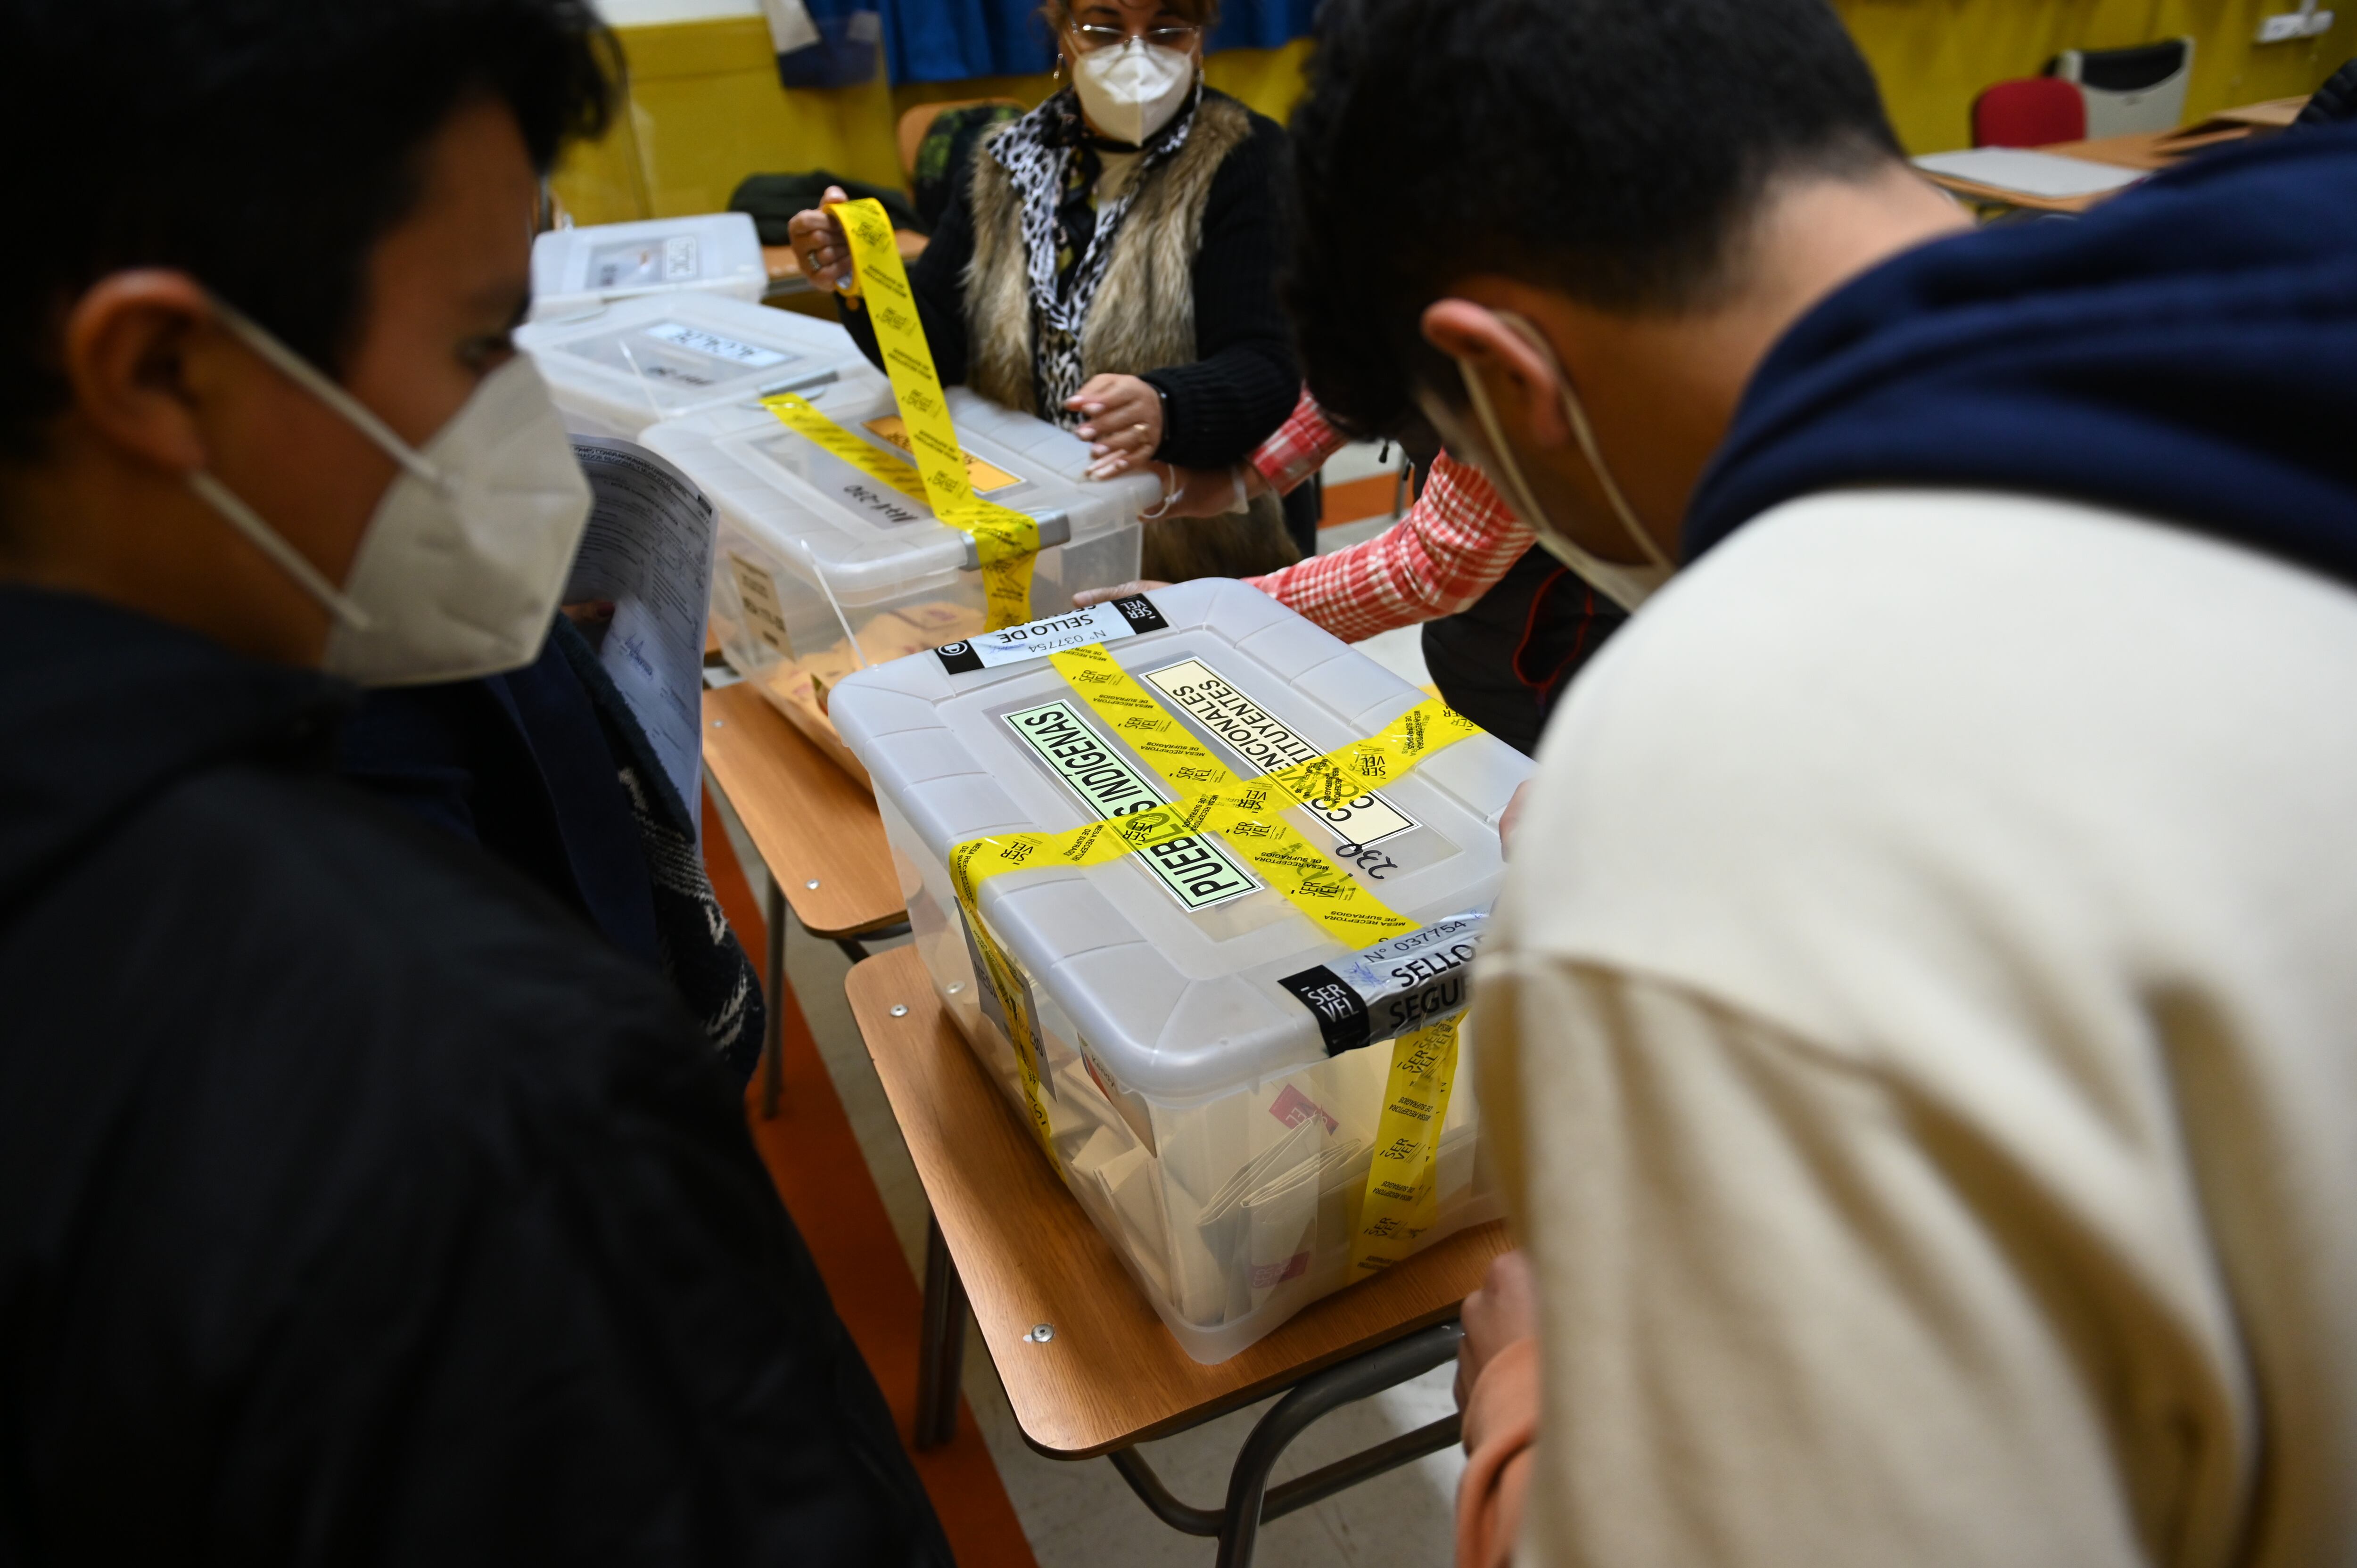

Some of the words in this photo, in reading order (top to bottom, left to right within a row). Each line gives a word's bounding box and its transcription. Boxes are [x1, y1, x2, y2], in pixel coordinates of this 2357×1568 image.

[1120, 600, 1146, 610] VEL
[1127, 607, 1152, 618] SER
[1031, 614, 1094, 636] SELLO
[997, 630, 1028, 644] DE
[1090, 630, 1107, 640] N°
[1029, 634, 1083, 653] 037754
[1062, 649, 1088, 658] RECEPT
[1079, 670, 1095, 682] SER
[1092, 674, 1112, 683] VEL
[1093, 698, 1133, 706] RECEPTORA
[1099, 694, 1136, 703] SUFRAGIOS
[1443, 709, 1460, 717] ER
[1124, 717, 1144, 729] SER
[1139, 719, 1159, 730] VEL
[1416, 722, 1424, 750] RECEPTORA
[1140, 745, 1183, 754] RECEPTORA
[1146, 742, 1187, 750] SUFRAGIOS
[1024, 710, 1144, 804] INDÍGENAS
[1361, 755, 1385, 767] VEL
[1176, 767, 1196, 779] SER
[1192, 769, 1212, 781] VEL
[1362, 766, 1386, 776] SER
[1206, 795, 1219, 806] MESA
[1246, 790, 1267, 801] VEL
[1238, 798, 1264, 810] SER
[1094, 824, 1104, 838] MESA
[1131, 821, 1153, 833] VEL
[1234, 821, 1255, 836] SER
[1250, 825, 1271, 837] VEL
[1122, 830, 1149, 842] SER
[959, 846, 969, 854] DE
[968, 842, 983, 855] MESA
[1011, 841, 1034, 854] VEL
[1113, 800, 1238, 898] PUEBLOS
[1000, 848, 1029, 862] SER
[1261, 852, 1308, 862] SUFRAGIOS
[1335, 843, 1398, 879] 230
[1254, 856, 1304, 867] RECEPTORA
[1299, 881, 1321, 896] SER
[1318, 884, 1340, 898] VEL
[1324, 915, 1377, 925] RECEPTORA
[1330, 911, 1382, 920] SUFRAGIOS
[1364, 948, 1386, 964] N°
[1393, 920, 1467, 951] 037754
[1391, 944, 1477, 988] SELLO
[1307, 984, 1347, 1005] SER
[1320, 997, 1360, 1023] VEL
[1402, 1051, 1428, 1072] SER
[1411, 1055, 1438, 1073] VEL
[1398, 1096, 1427, 1110] SUFRAGIOS
[1389, 1104, 1418, 1117] RECEPTORA
[1385, 1138, 1409, 1158] SER
[1393, 1142, 1418, 1159] VEL
[1368, 1217, 1392, 1236] SER
[1377, 1221, 1400, 1236] VEL
